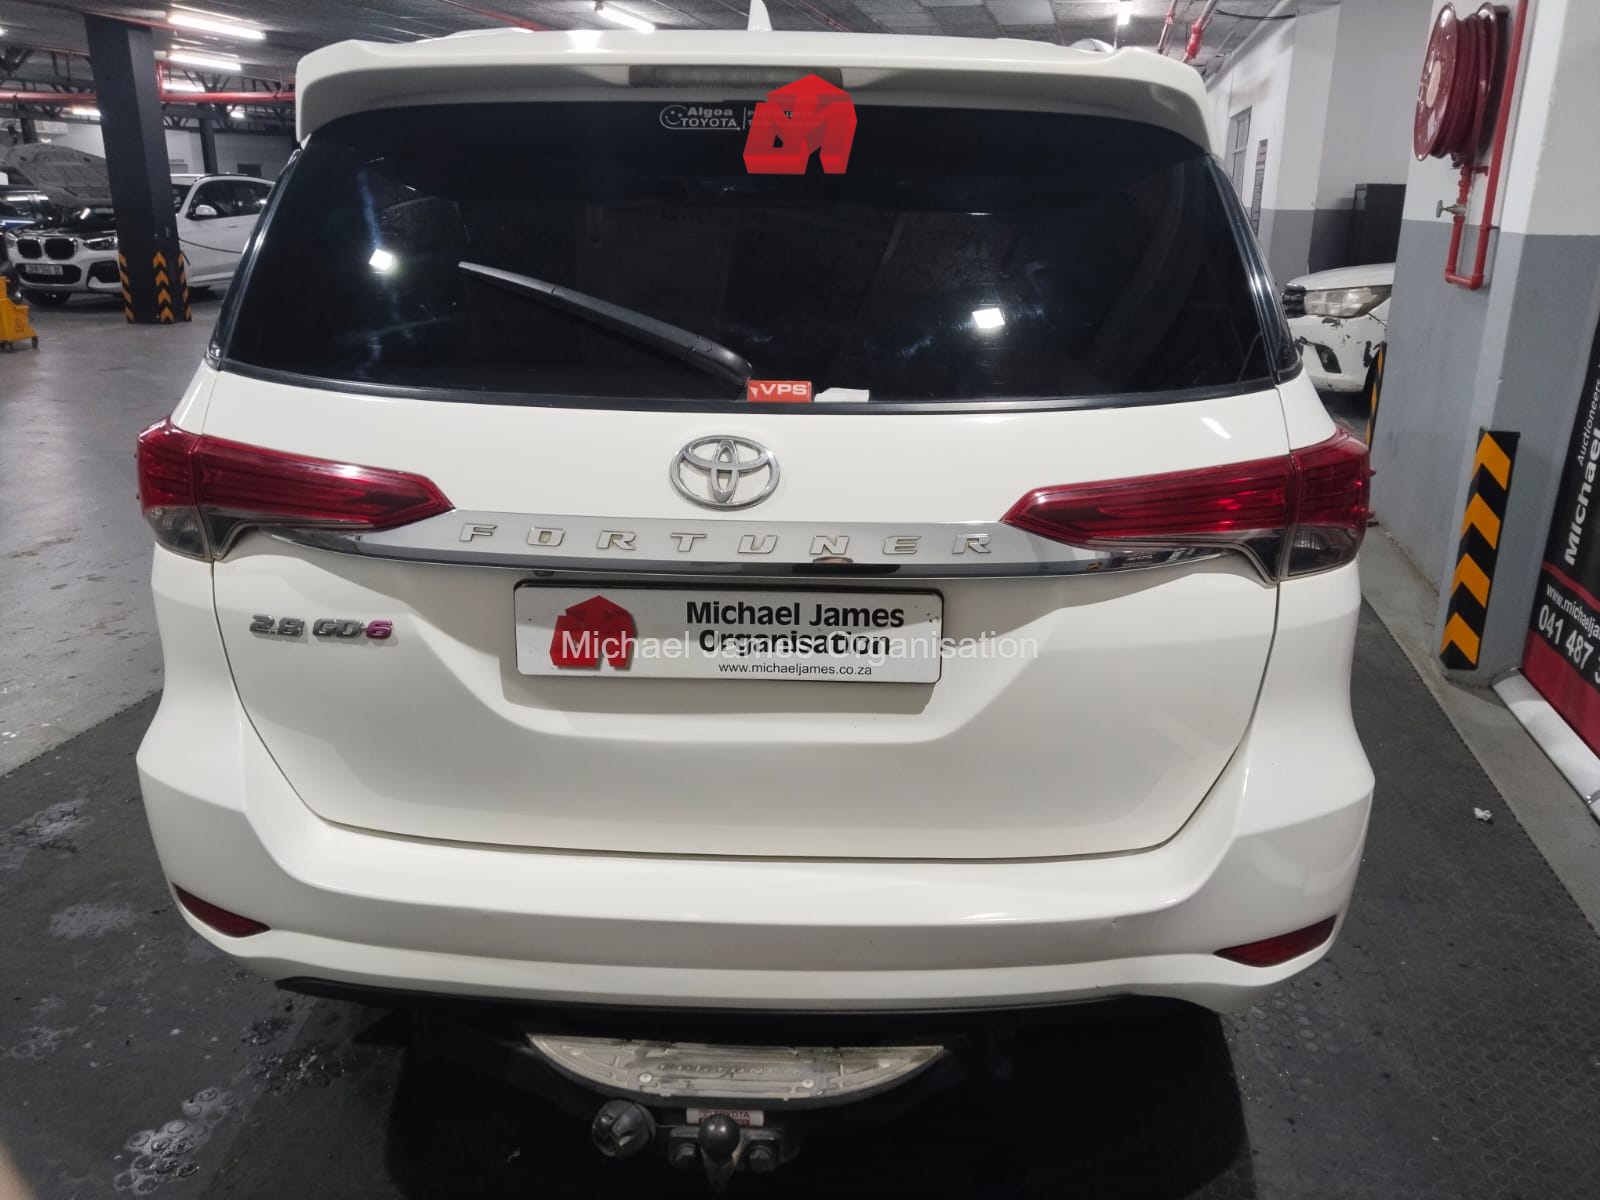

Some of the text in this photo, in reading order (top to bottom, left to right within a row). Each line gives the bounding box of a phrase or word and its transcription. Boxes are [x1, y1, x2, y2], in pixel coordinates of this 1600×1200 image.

[680, 118, 737, 127] TOYOTA
[687, 106, 733, 117] Algoa
[760, 383, 807, 395] VPS
[1577, 378, 1600, 467] Auctioneer
[459, 524, 993, 556] FORTUNER
[249, 614, 304, 637] 2.8
[686, 601, 905, 628] Michael James
[698, 629, 890, 657] Organisation
[1539, 604, 1564, 645] 041
[1565, 629, 1594, 670] 487
[718, 663, 872, 676] www.michaeljames.co.za
